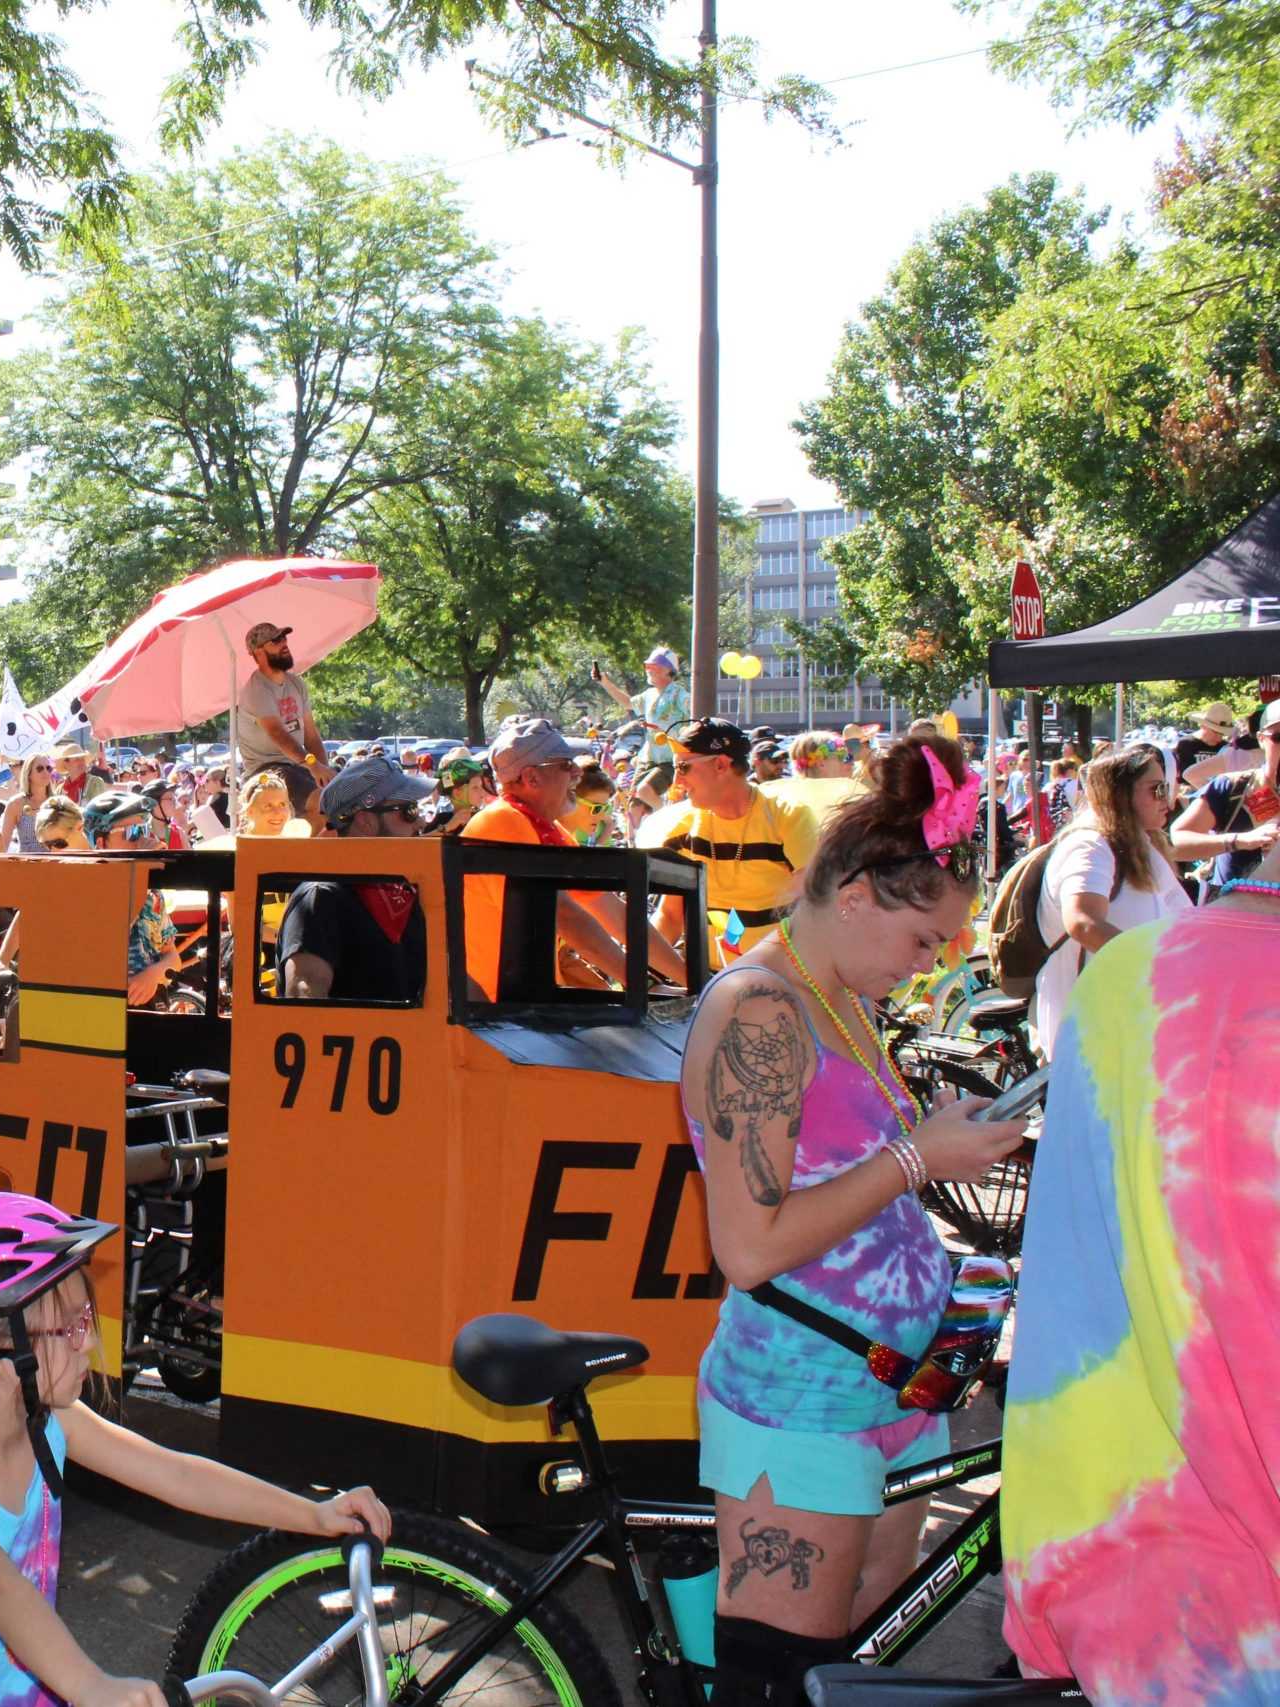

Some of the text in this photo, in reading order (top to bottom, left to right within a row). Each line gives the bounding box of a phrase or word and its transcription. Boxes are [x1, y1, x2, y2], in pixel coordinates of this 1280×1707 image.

[1014, 594, 1041, 636] STOP
[1159, 613, 1244, 628] FORT
[1171, 598, 1244, 617] BIKE
[273, 1032, 403, 1116] 970
